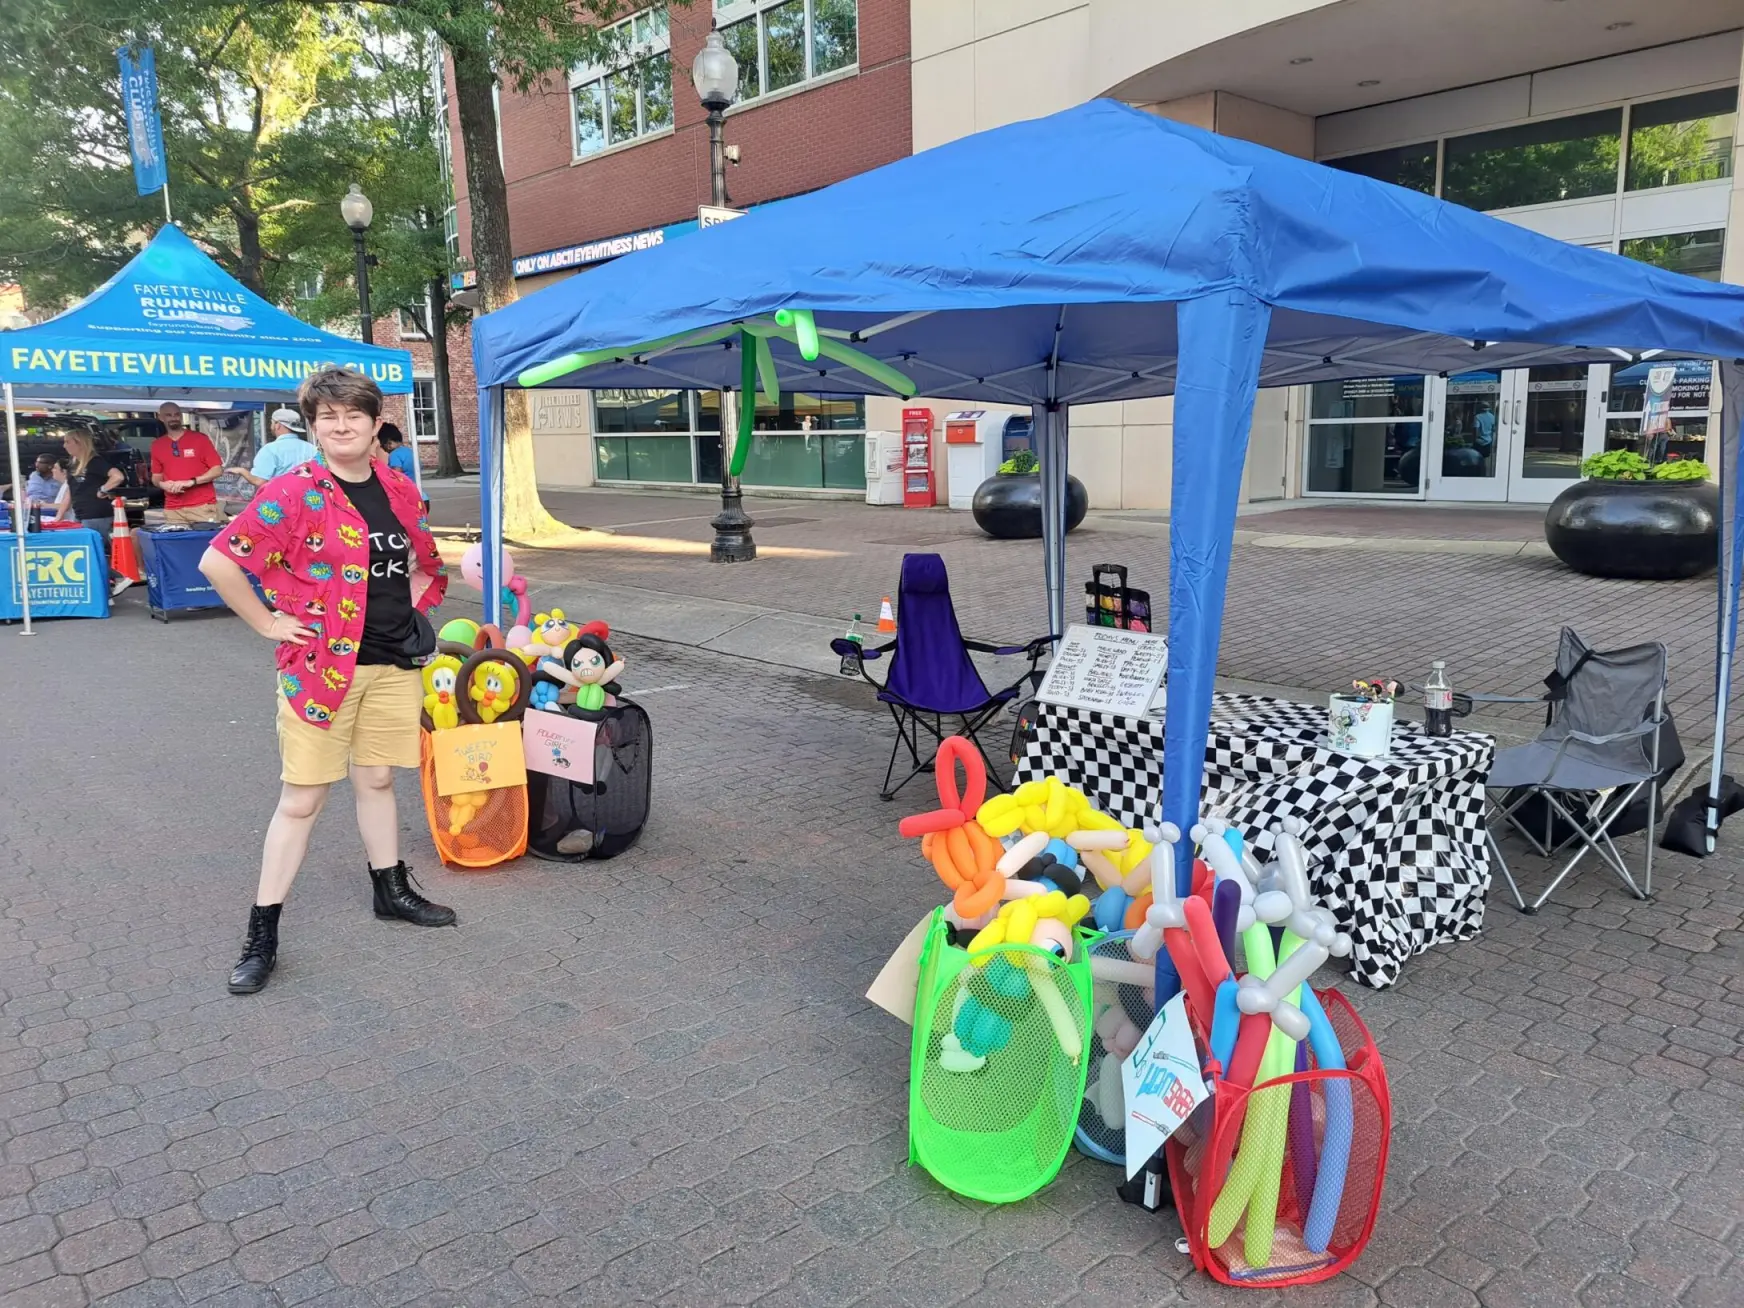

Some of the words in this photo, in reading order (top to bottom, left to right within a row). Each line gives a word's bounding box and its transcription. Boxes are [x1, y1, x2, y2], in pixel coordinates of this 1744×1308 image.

[515, 256, 537, 274] ONLY
[537, 253, 549, 270] ON
[575, 237, 632, 262] EYEWITNESS
[633, 230, 664, 251] NEWS
[134, 284, 247, 304] FAYETTEVILLE
[140, 297, 242, 315] RUNNING
[142, 308, 198, 319] CLUB
[11, 347, 215, 376] FAYETTEVILLE
[222, 356, 338, 379] RUNNIN
[344, 362, 403, 382] LUB
[17, 550, 85, 585] FRC
[543, 738, 569, 751] GIRLS
[467, 751, 493, 765] BIRD
